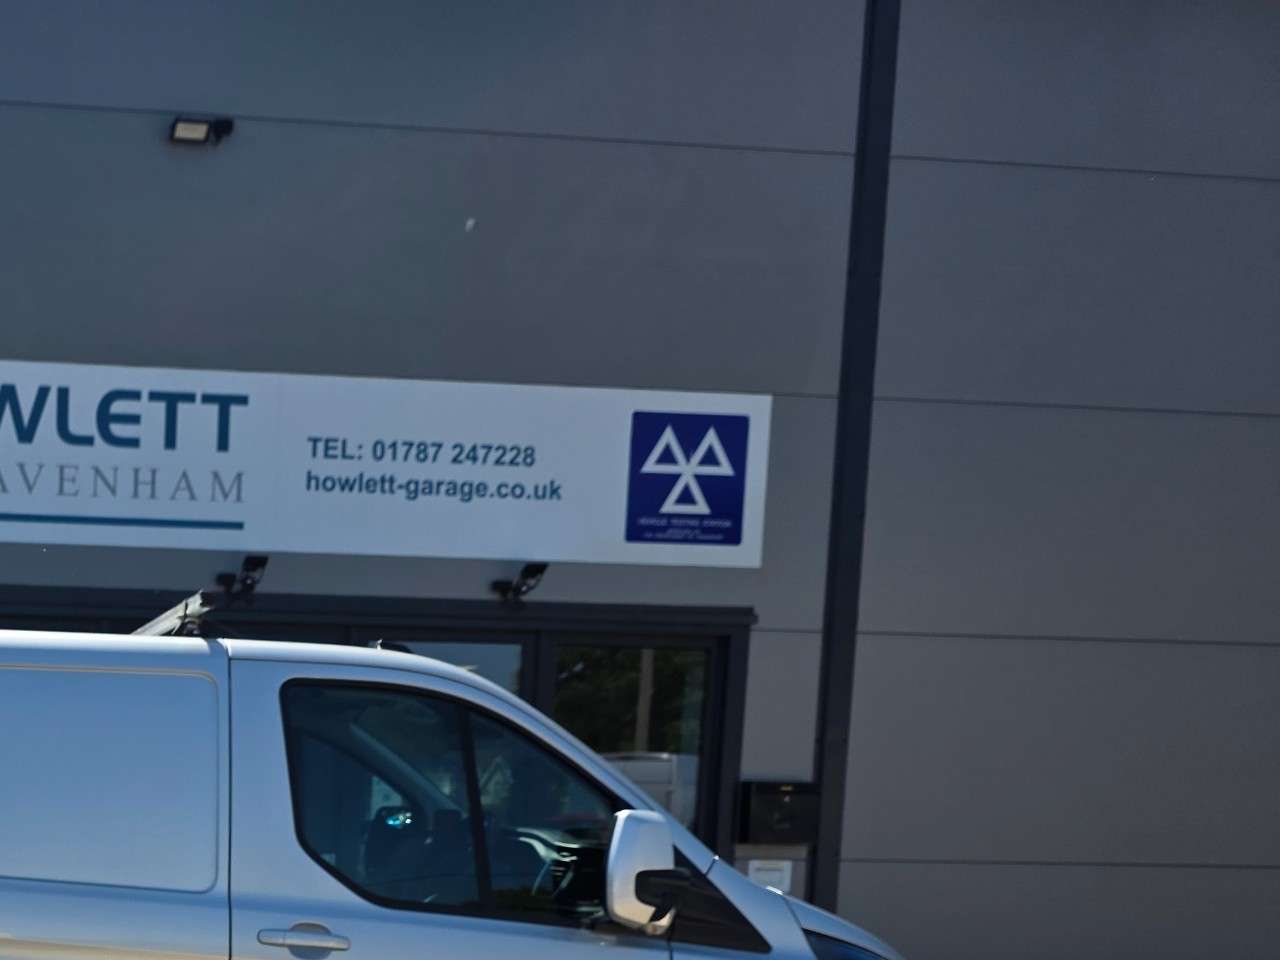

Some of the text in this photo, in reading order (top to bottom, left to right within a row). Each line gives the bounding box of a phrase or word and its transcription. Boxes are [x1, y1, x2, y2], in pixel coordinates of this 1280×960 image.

[307, 436, 536, 468] TEL: 01787 247228
[305, 470, 563, 502] howlett-garage.co.uk
